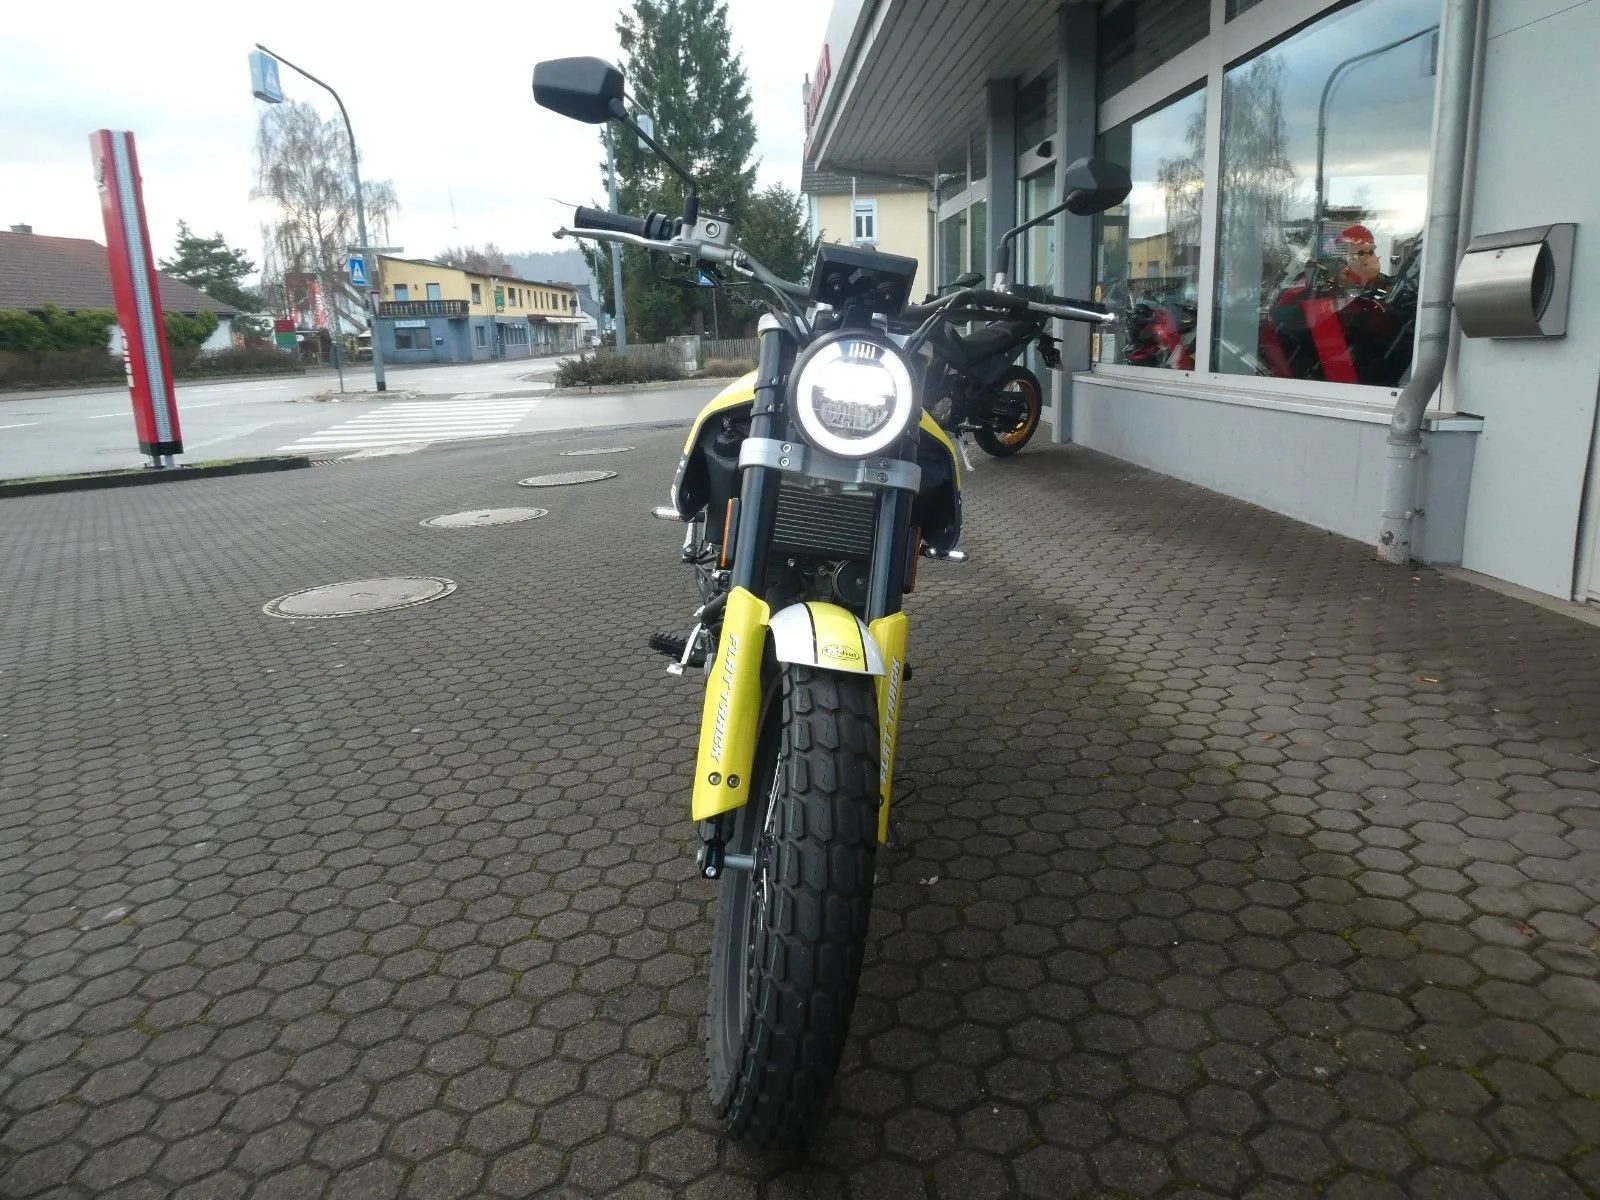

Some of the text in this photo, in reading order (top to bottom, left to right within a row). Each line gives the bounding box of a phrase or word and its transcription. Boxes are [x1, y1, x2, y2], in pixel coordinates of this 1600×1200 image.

[711, 632, 739, 764] FLAT TRACK
[880, 655, 900, 784] FLAT TRACK
